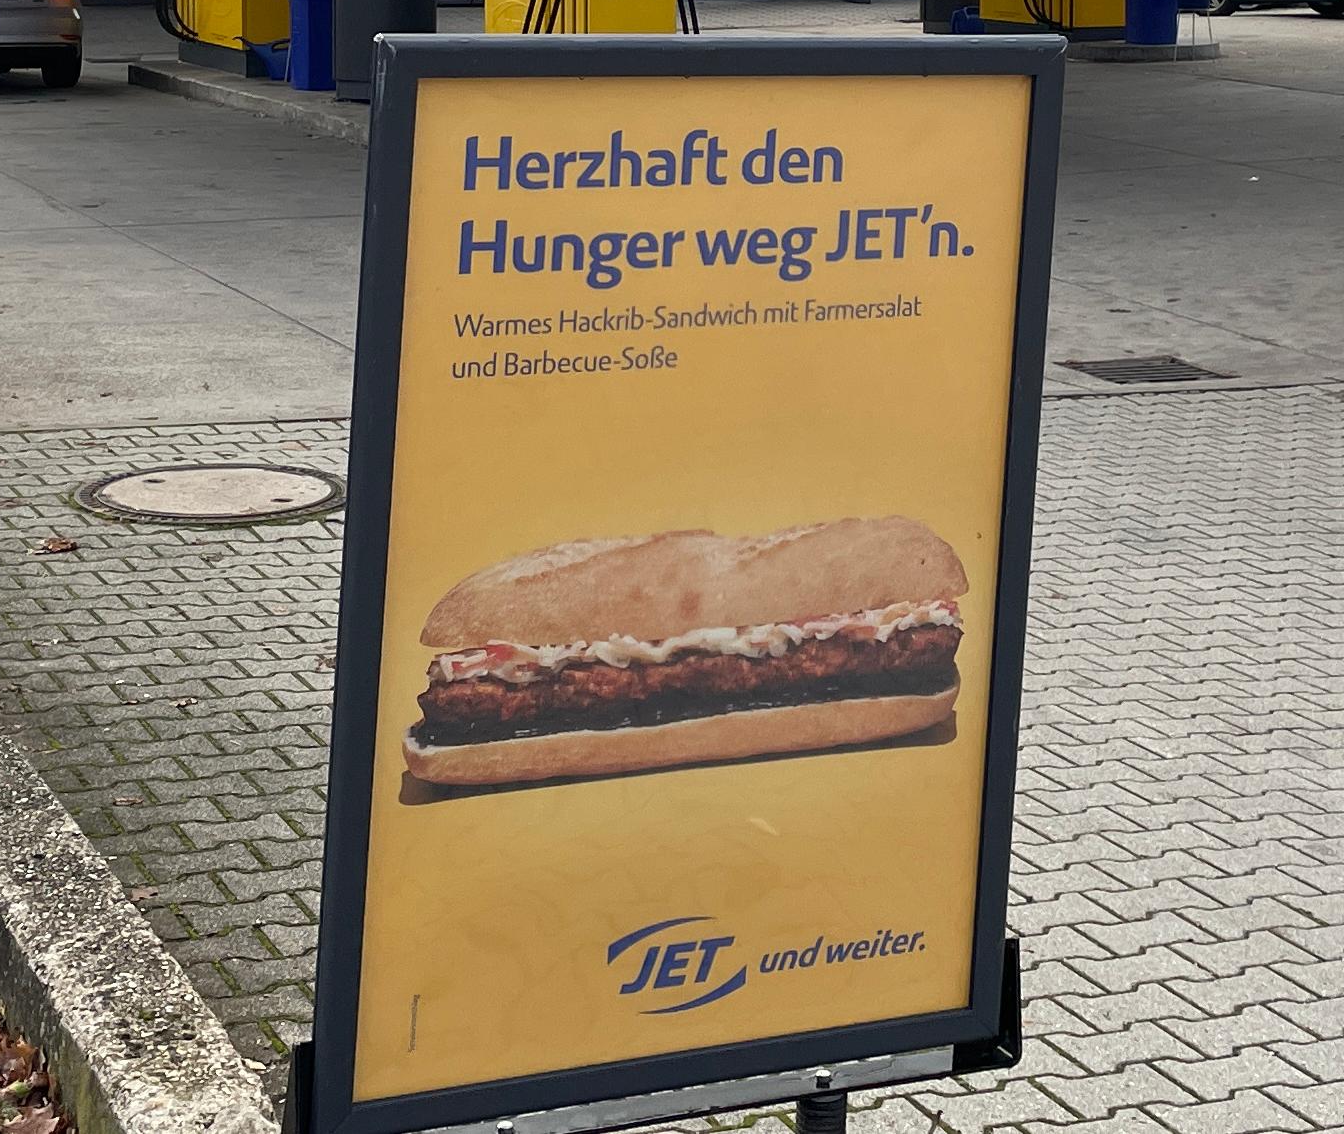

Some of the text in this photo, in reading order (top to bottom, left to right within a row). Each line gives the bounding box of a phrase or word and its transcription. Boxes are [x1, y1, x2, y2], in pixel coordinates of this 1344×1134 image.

[463, 128, 844, 191] Herzhaft den
[458, 220, 686, 290] Hunger
[696, 225, 818, 283] weg
[454, 294, 923, 338] Warmes Hackrib-Sandwich mit Farmersalat
[452, 344, 678, 379] und Barbecue-Soße
[619, 929, 927, 994] JET und weiter.
